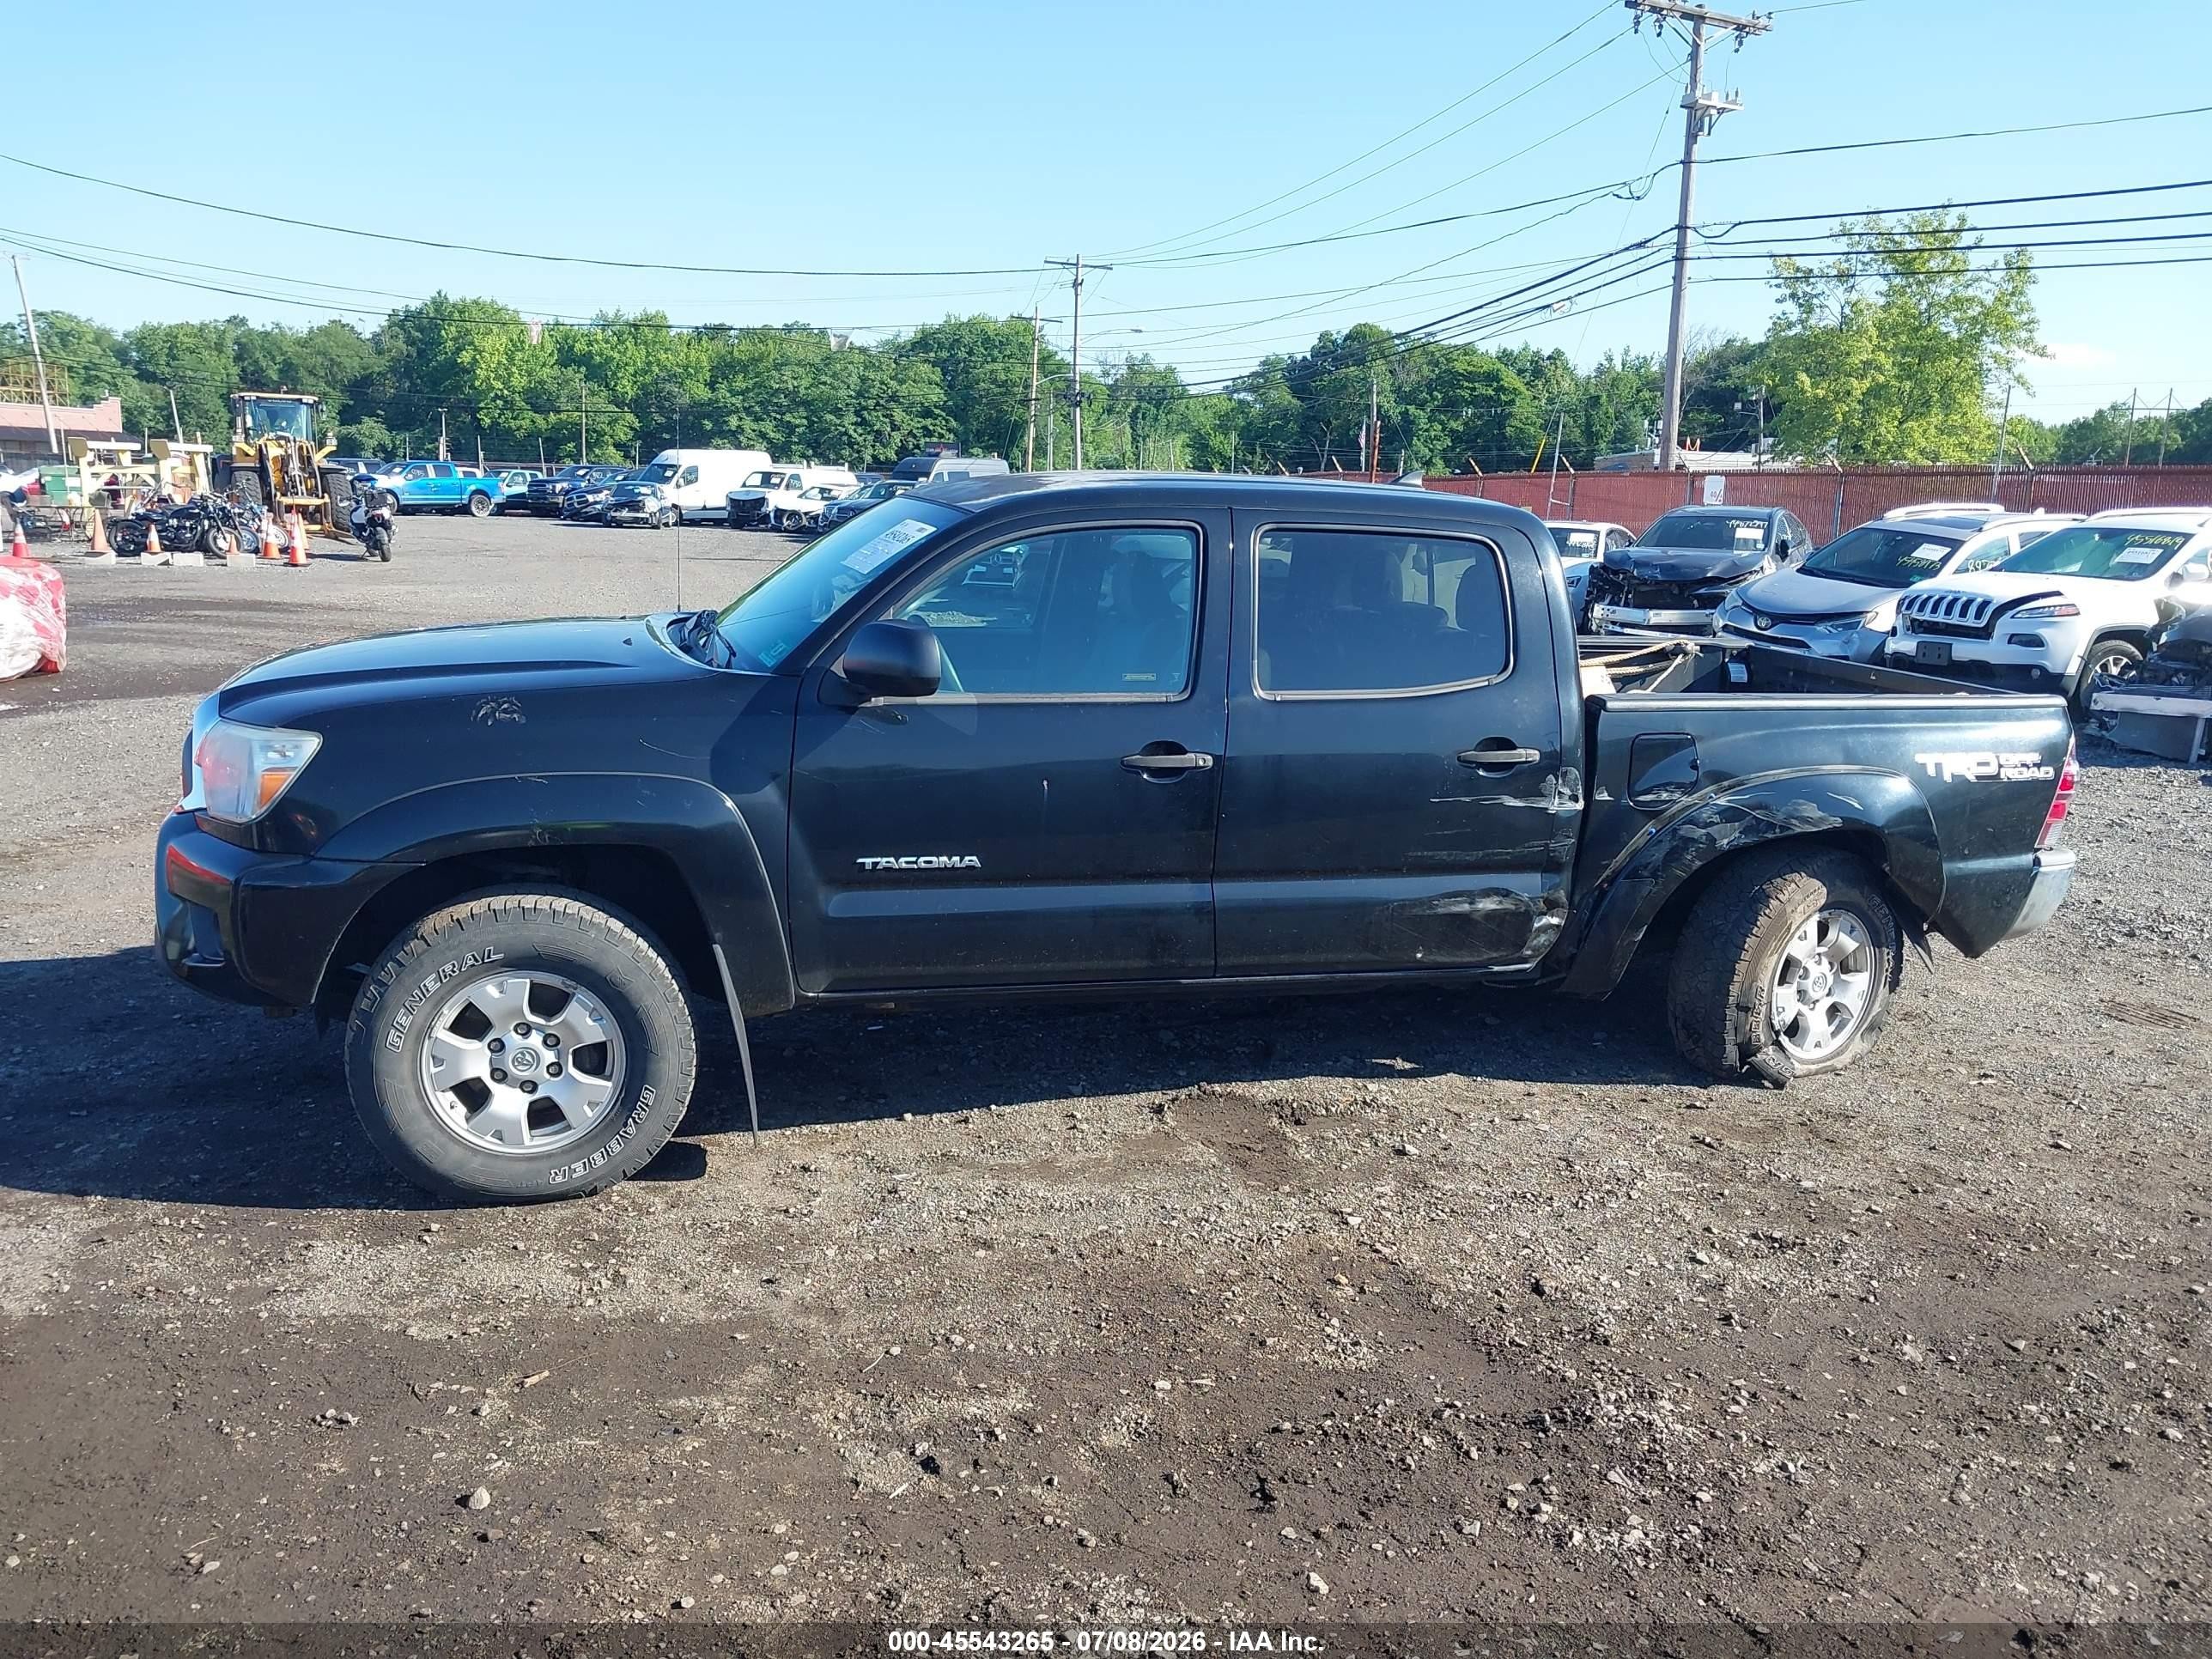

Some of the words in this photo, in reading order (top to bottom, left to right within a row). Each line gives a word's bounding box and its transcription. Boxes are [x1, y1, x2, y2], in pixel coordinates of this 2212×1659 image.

[1915, 752, 1999, 783] TRD
[1999, 766, 2056, 781] ROAD
[856, 855, 982, 870] TACOMA
[386, 945, 505, 1053] GENERAL
[549, 1085, 656, 1184] GRABBER
